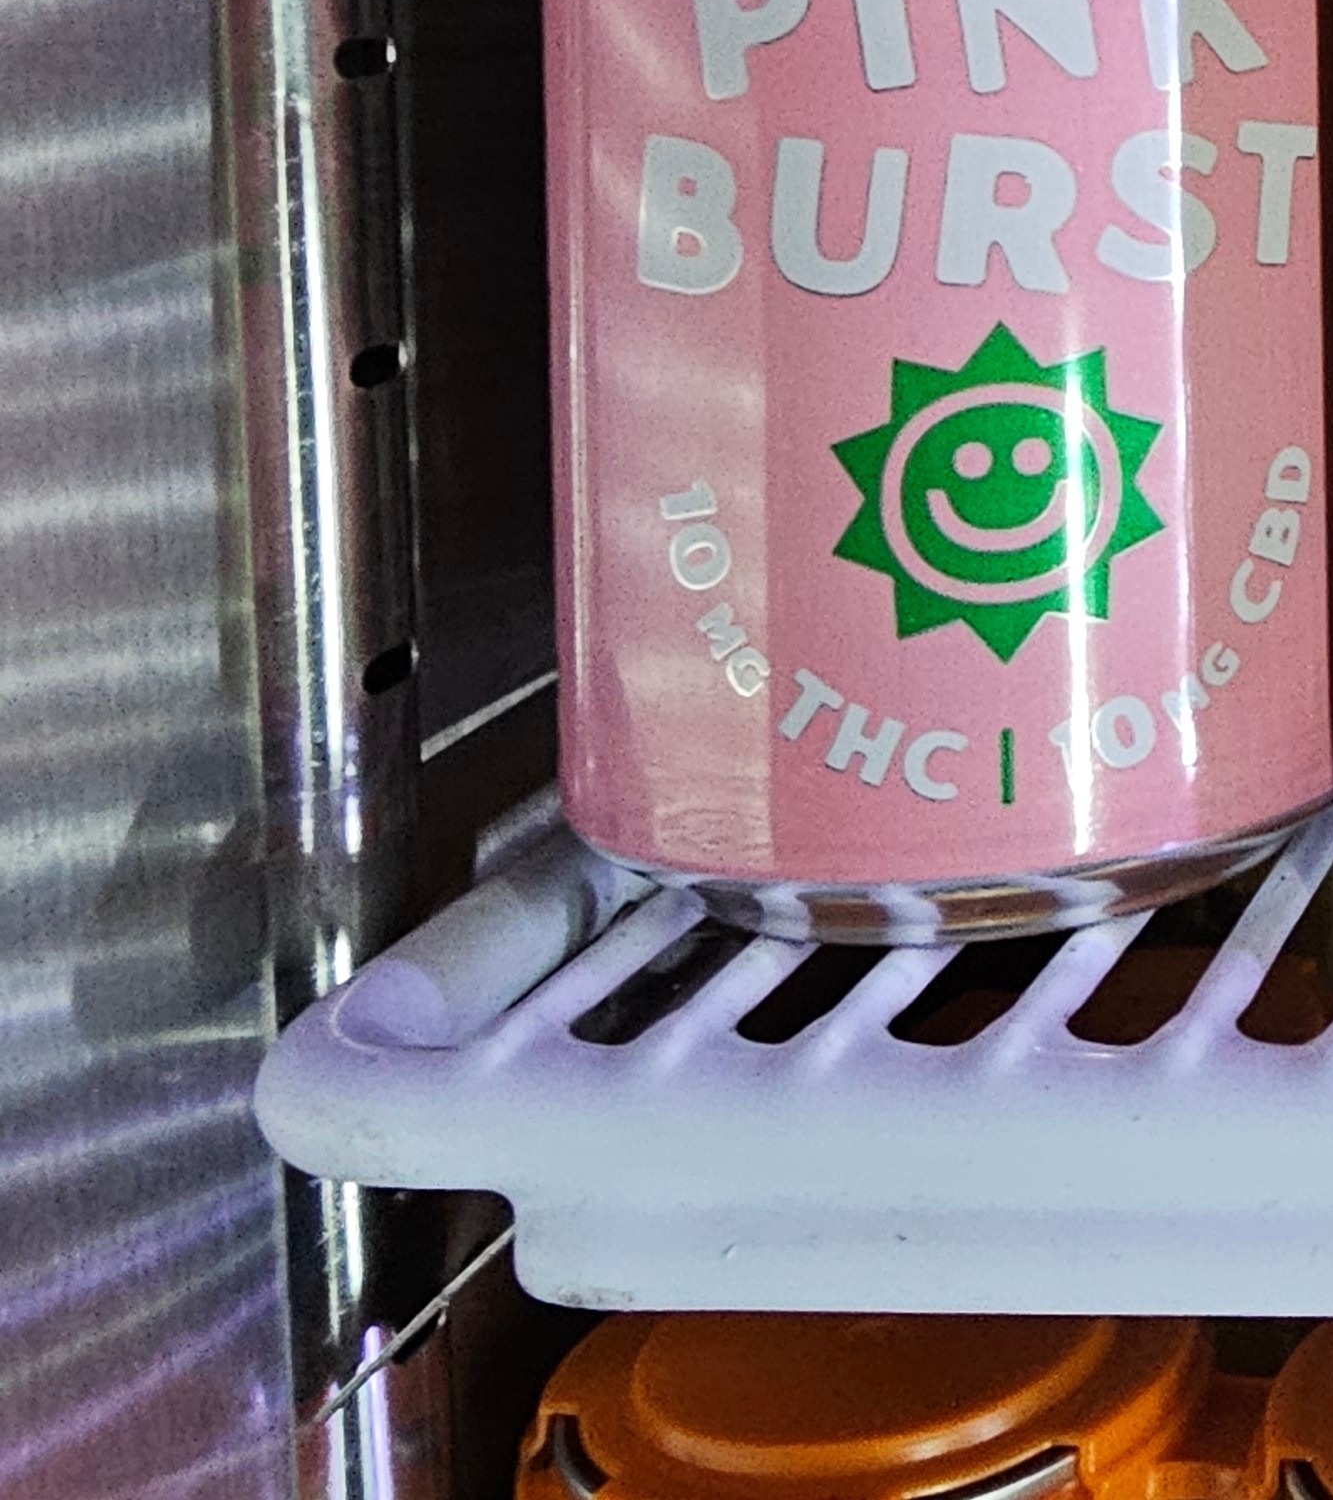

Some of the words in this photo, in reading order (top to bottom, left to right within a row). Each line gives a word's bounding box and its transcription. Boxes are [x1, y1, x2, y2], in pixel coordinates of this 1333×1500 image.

[637, 120, 1318, 297] BURST
[778, 669, 970, 801] THC
[1229, 445, 1311, 623] CBD
